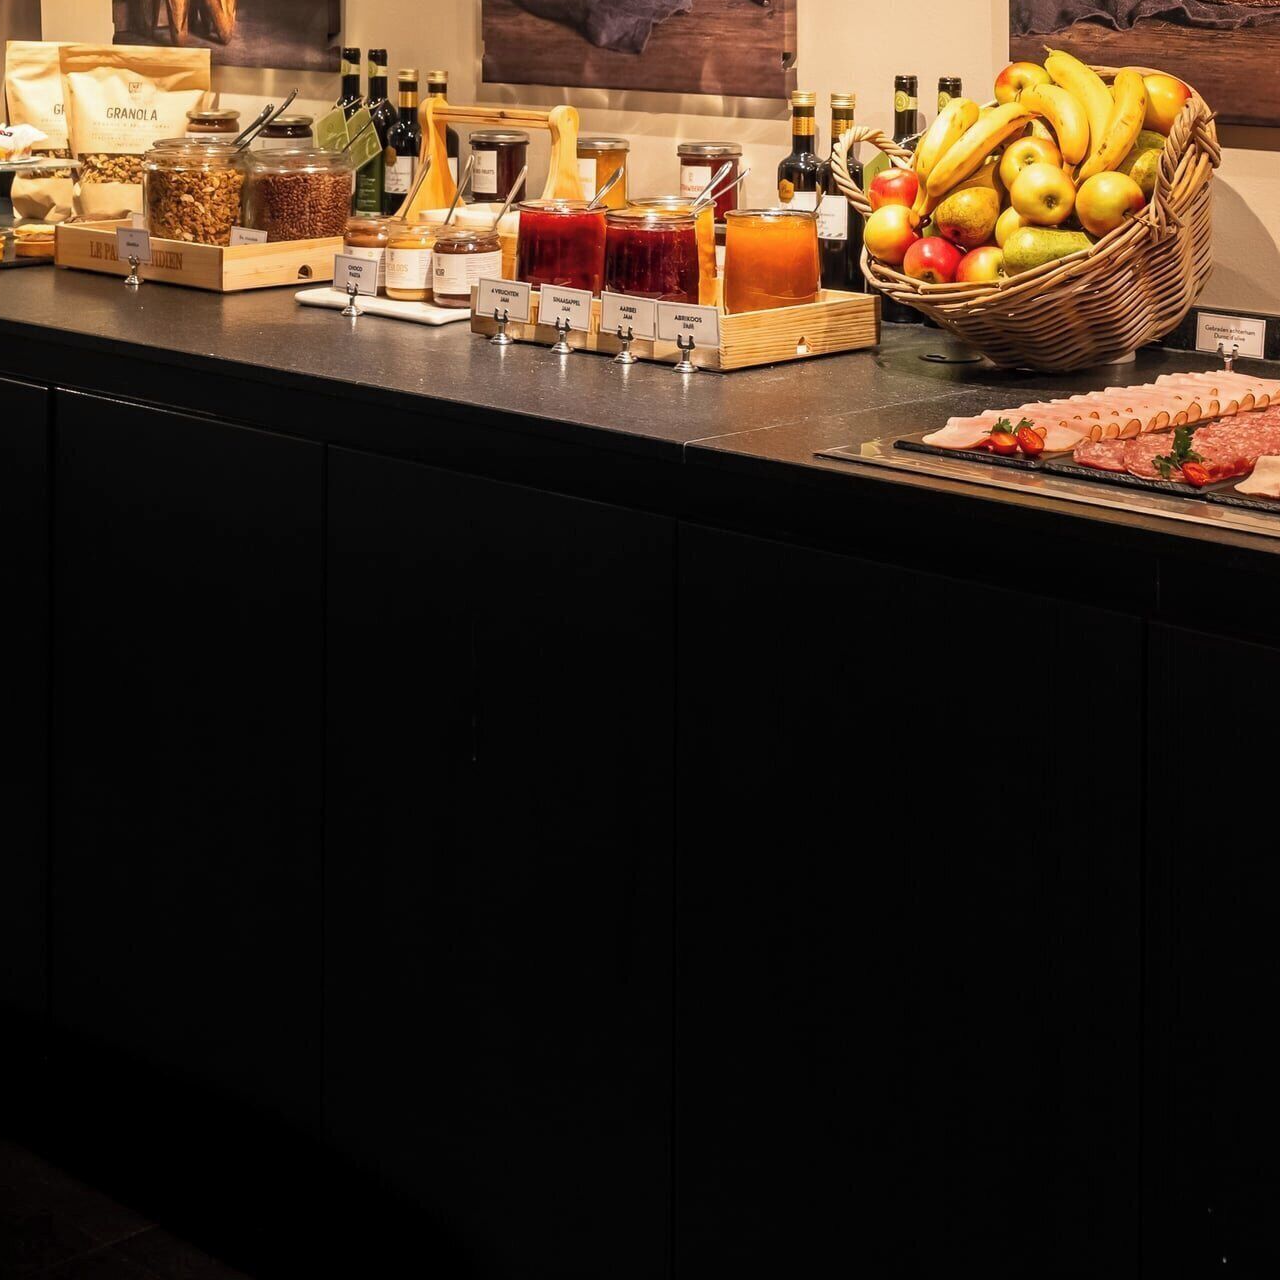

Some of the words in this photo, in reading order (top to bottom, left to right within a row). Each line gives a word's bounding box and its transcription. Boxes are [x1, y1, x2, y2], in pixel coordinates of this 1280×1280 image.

[106, 107, 158, 121] GRANOLA
[90, 241, 102, 260] LE
[674, 315, 703, 323] ABRIKOOS
